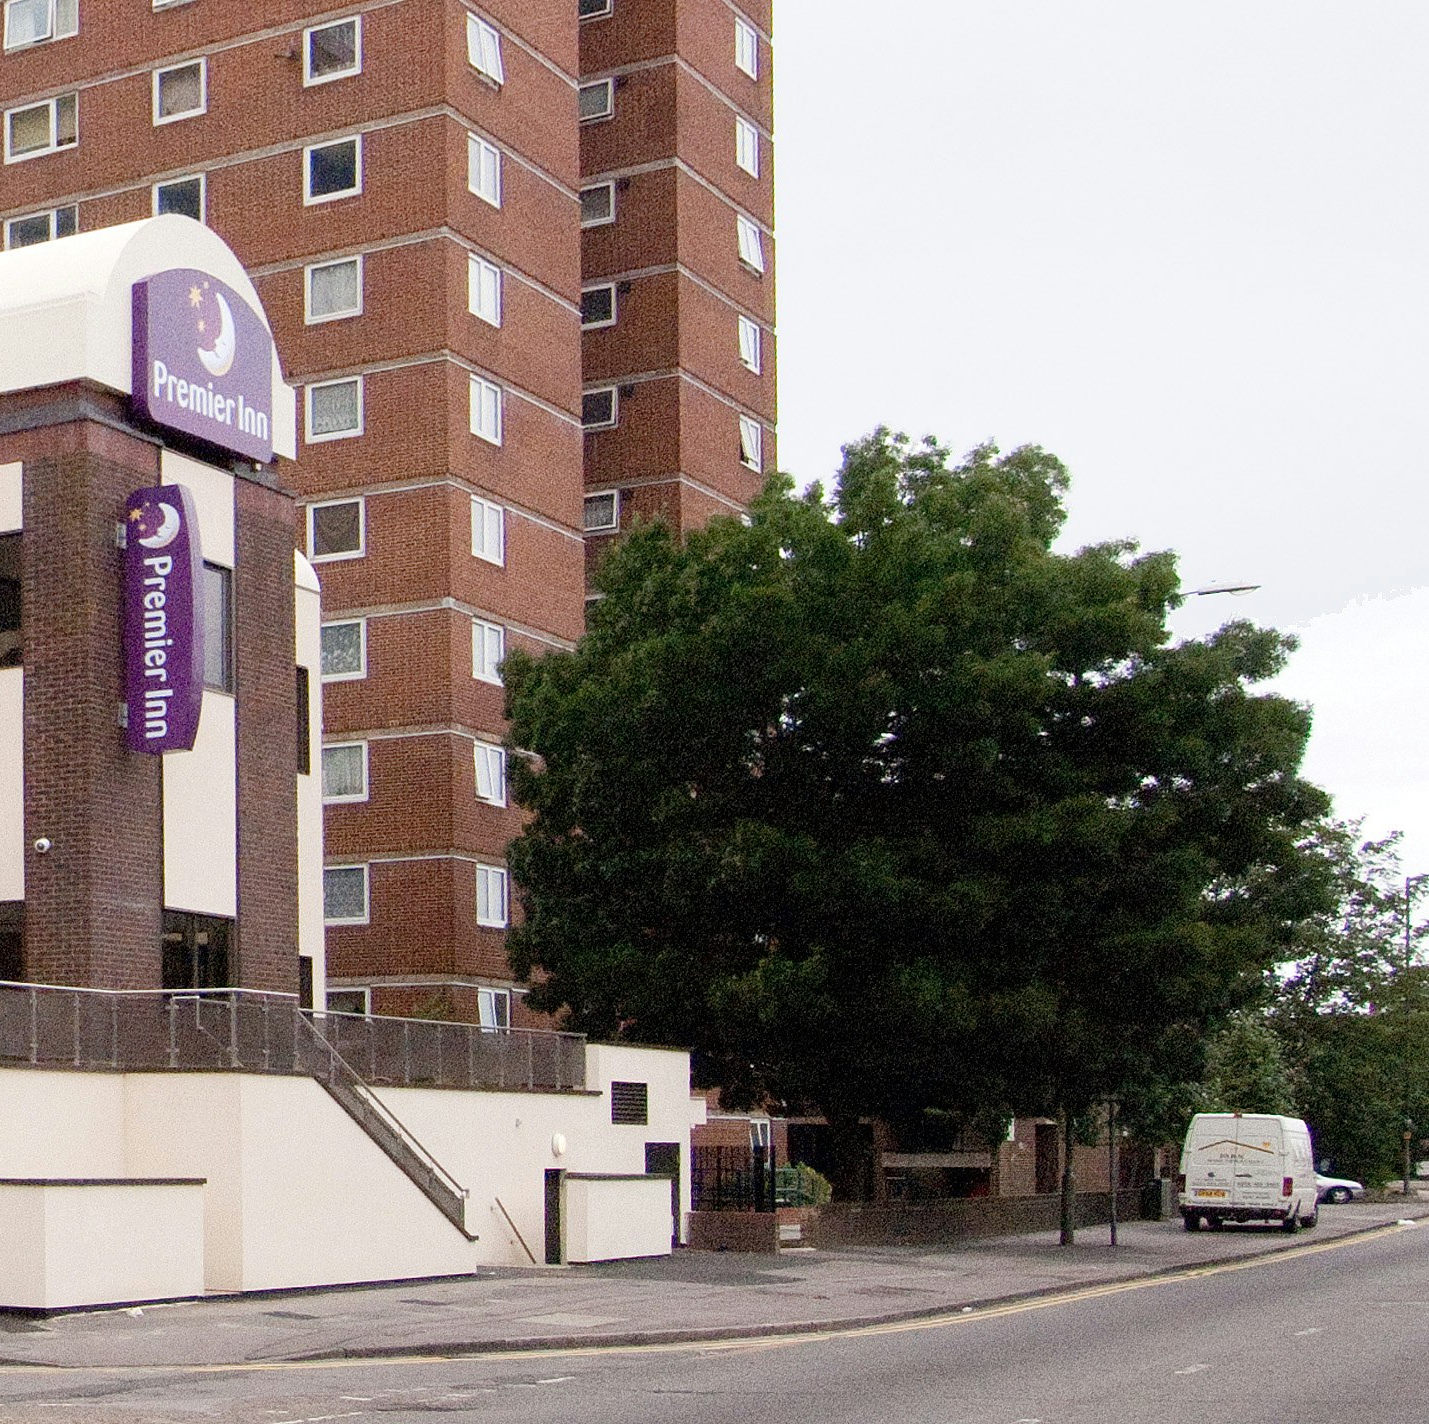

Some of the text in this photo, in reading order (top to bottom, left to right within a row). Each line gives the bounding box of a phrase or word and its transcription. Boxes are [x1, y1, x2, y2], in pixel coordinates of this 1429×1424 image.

[153, 359, 268, 441] Premier Inn
[143, 555, 173, 739] Premier Inn
